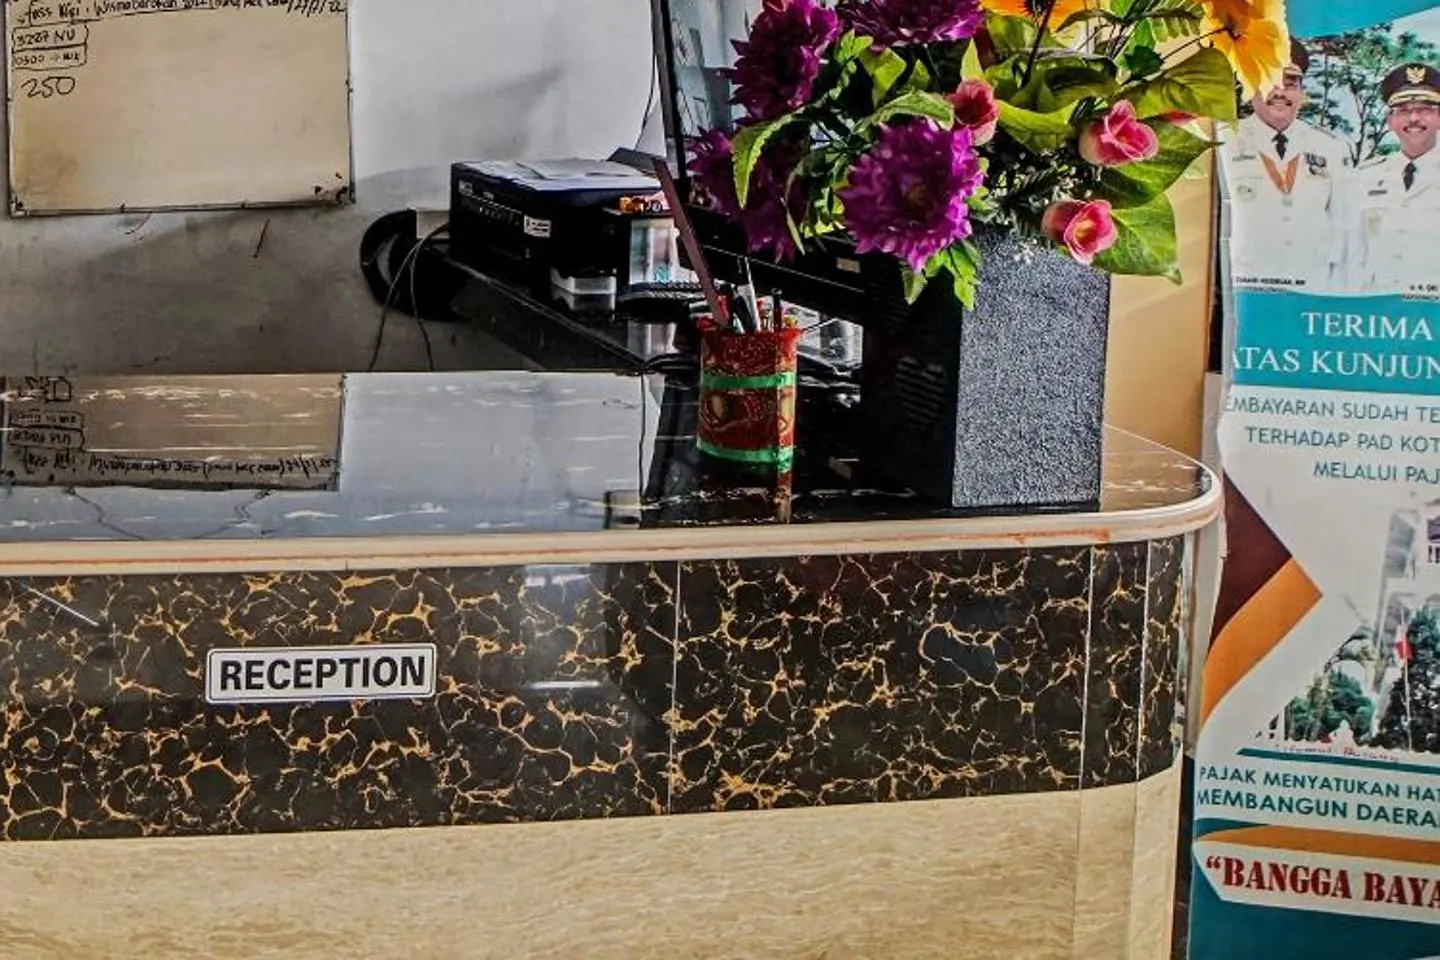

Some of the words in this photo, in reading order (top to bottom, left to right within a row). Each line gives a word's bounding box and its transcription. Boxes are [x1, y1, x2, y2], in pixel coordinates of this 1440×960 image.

[20, 75, 77, 99] 250
[1300, 311, 1433, 341] TERIMA
[1343, 401, 1409, 422] SUDAH
[1244, 426, 1350, 448] TERHADAP
[1358, 433, 1393, 451] PAD
[1313, 460, 1397, 481] MELALUI
[219, 655, 426, 692] RECEPTION
[1200, 765, 1257, 785] PAJAK
[1263, 771, 1400, 798] MENYATUKAN
[1196, 788, 1348, 819] MEMBANGUN
